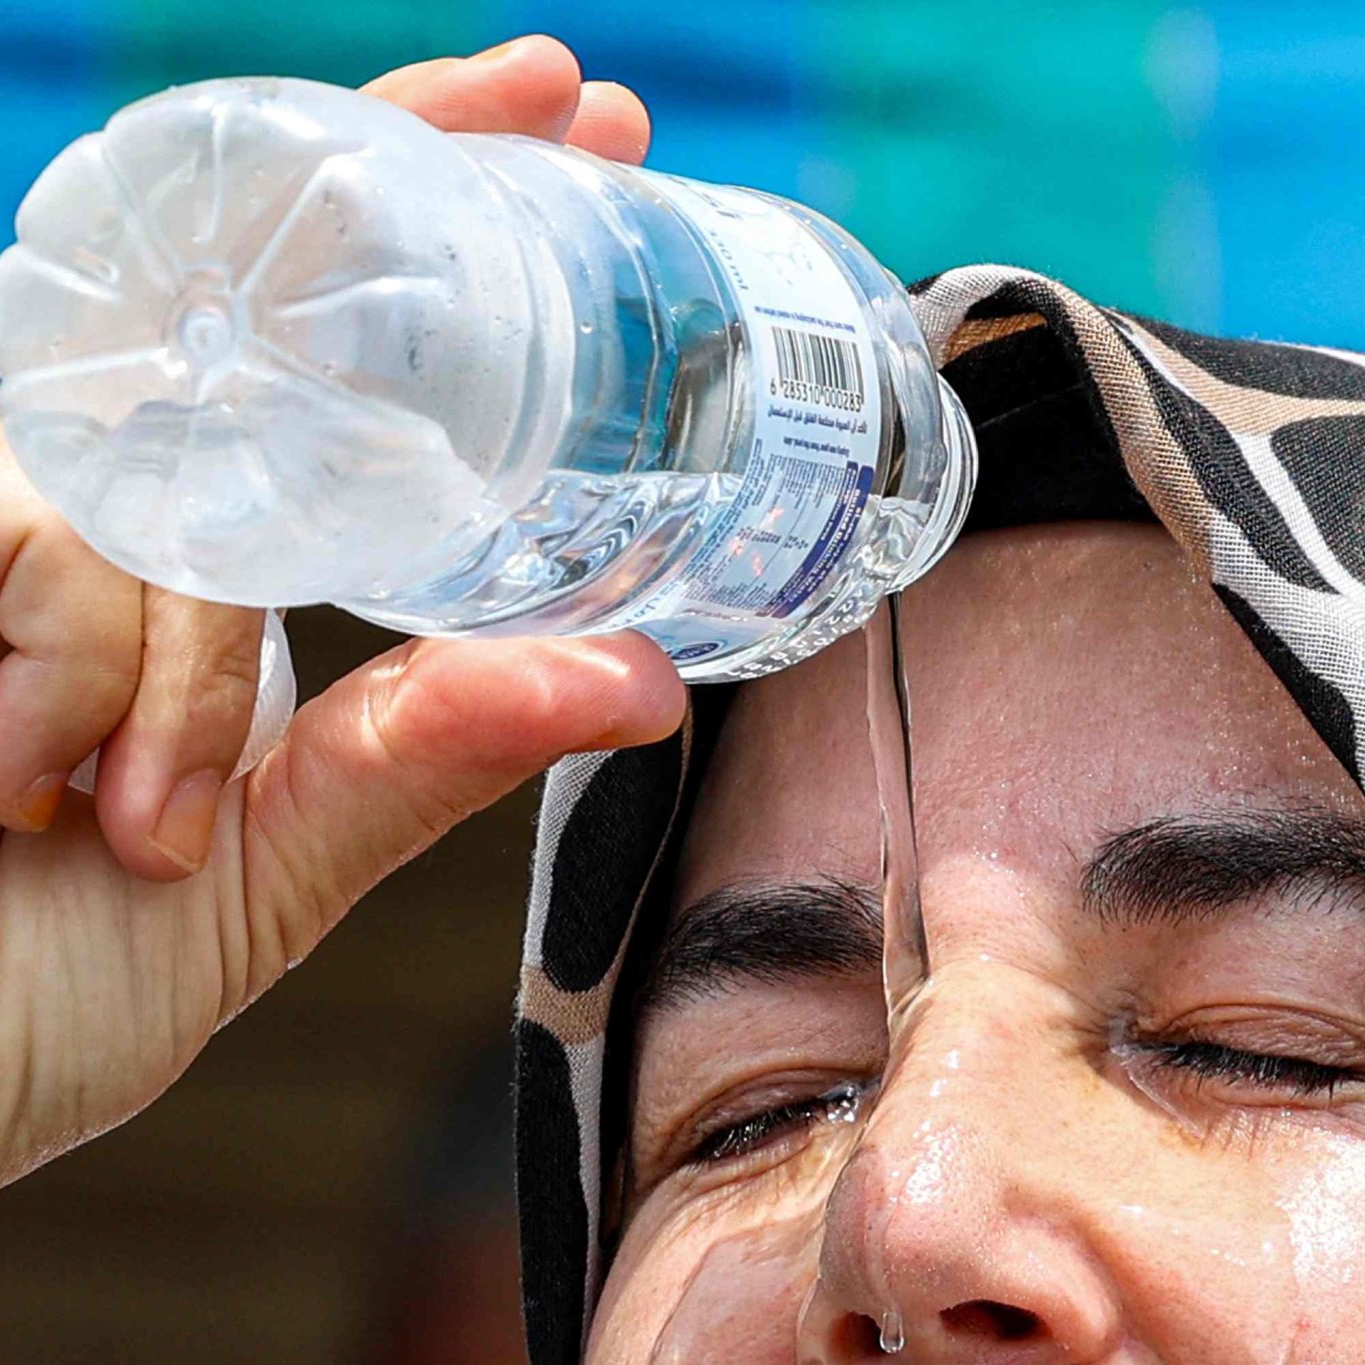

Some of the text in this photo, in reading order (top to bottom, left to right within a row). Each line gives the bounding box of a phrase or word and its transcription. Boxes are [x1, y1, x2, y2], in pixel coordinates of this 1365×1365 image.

[770, 377, 861, 413] 6 285310 000283
